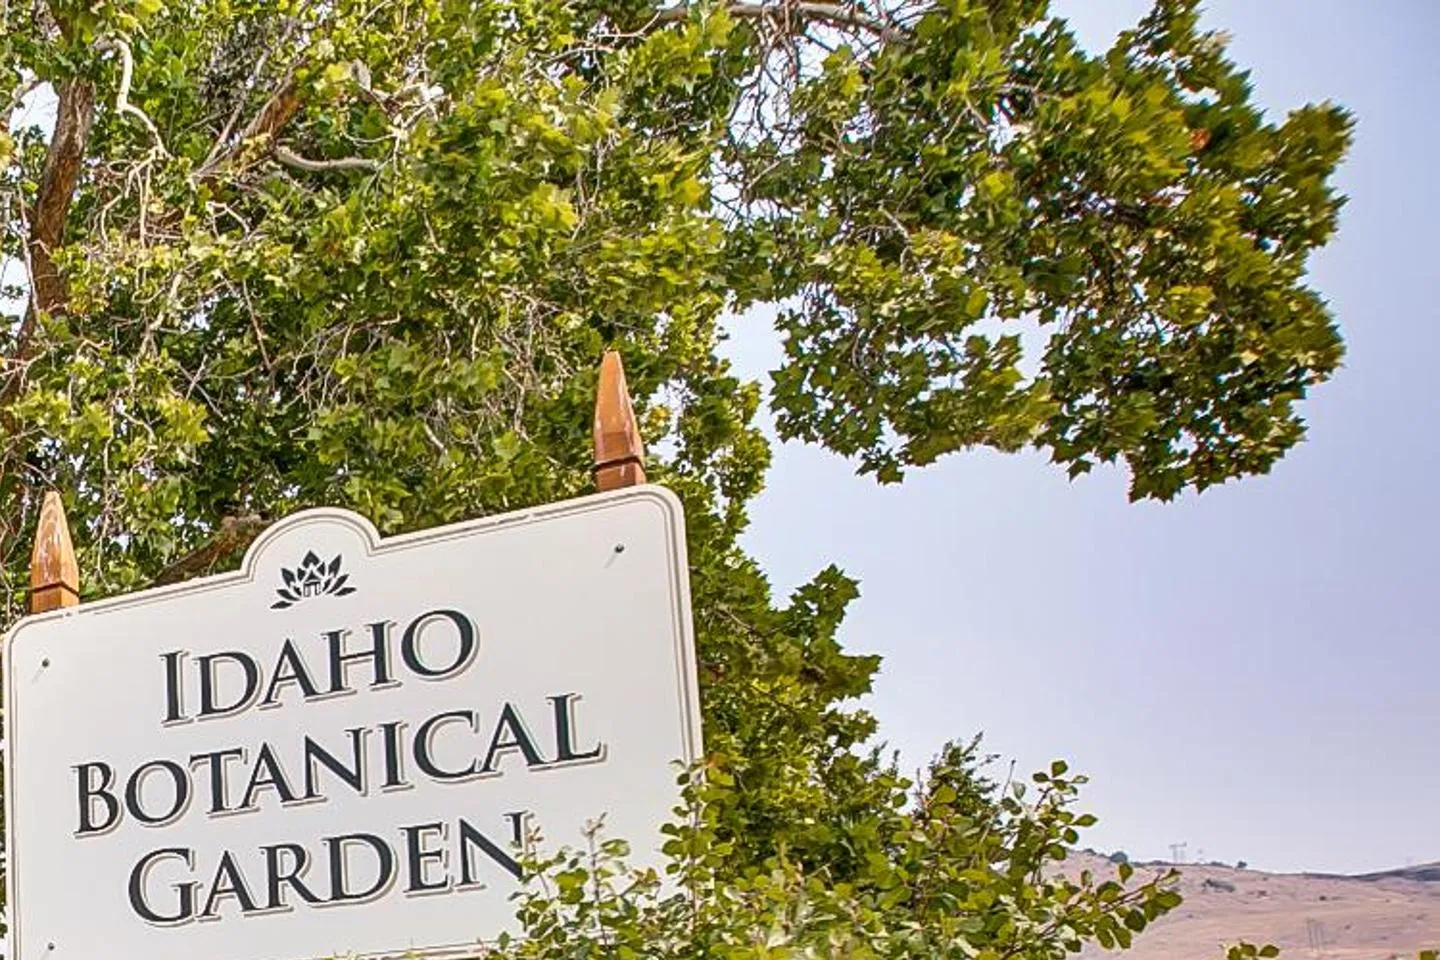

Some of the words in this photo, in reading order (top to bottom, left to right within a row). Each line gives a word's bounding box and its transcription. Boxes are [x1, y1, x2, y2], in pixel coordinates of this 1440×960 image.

[159, 608, 474, 724] IDAHO
[71, 693, 602, 834] BOTANICAL
[127, 809, 529, 923] GARDEN
